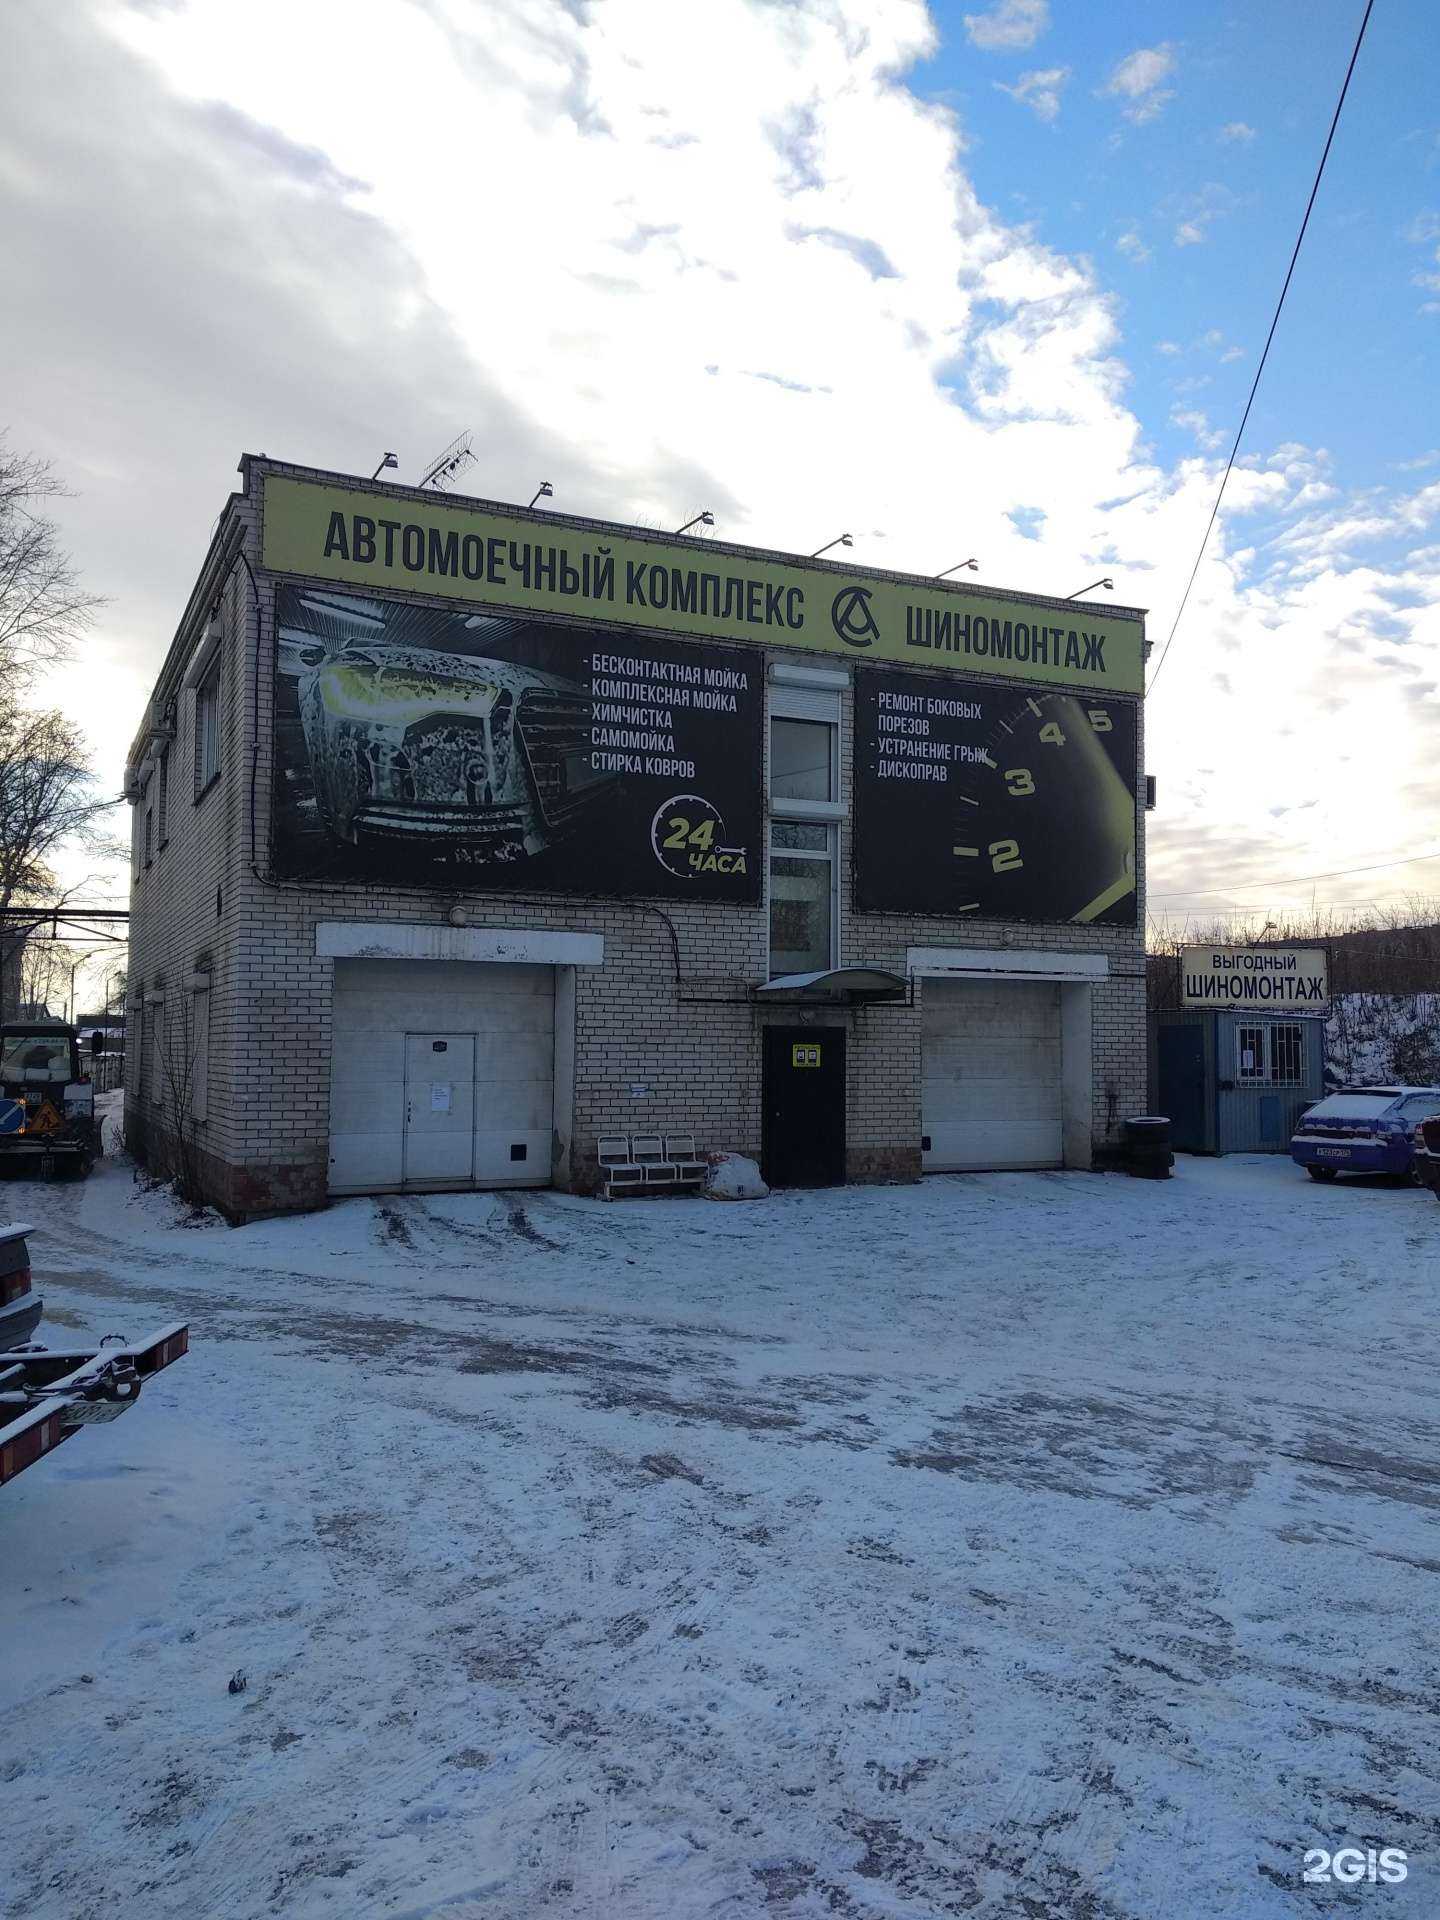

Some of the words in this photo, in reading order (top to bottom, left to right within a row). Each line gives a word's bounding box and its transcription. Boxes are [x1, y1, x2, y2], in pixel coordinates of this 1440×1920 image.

[323, 511, 616, 601] АВТОМОЕЧНЫЙ
[626, 561, 805, 630] КОМПЛЕКС
[906, 606, 1106, 673] ШИНОМОНТАЖ
[592, 653, 701, 685] БЕСКОНТАКТНАЯ
[704, 667, 748, 690] МОЙКА
[591, 678, 690, 707] КОМПЛЕКСНАЯ
[692, 689, 737, 713] МОЙКА
[878, 691, 925, 713] РЕМОНТ
[926, 698, 982, 720] БОКОВЫХ
[591, 702, 673, 729] ХИМЧИСТКА
[878, 714, 930, 736] ПОРЕЗОВ
[1087, 709, 1114, 732] 5
[591, 726, 675, 753] САМОМОЙКА
[1038, 722, 1066, 746] 4
[878, 736, 951, 761] УСТРАНЕНИЕ
[954, 744, 989, 764] ГРЫЖ
[591, 751, 642, 774] СТИРКА
[645, 757, 696, 779] КОВРОВ
[877, 759, 948, 782] ДИСКОПРАВ
[1004, 768, 1036, 796] 3
[662, 817, 715, 851] 24
[688, 852, 747, 874] ЧАСА
[988, 839, 1024, 873] 2
[1212, 954, 1297, 972] ВЫГОДНЫЙ
[1186, 974, 1324, 1000] ШИНОМОНТАЖ
